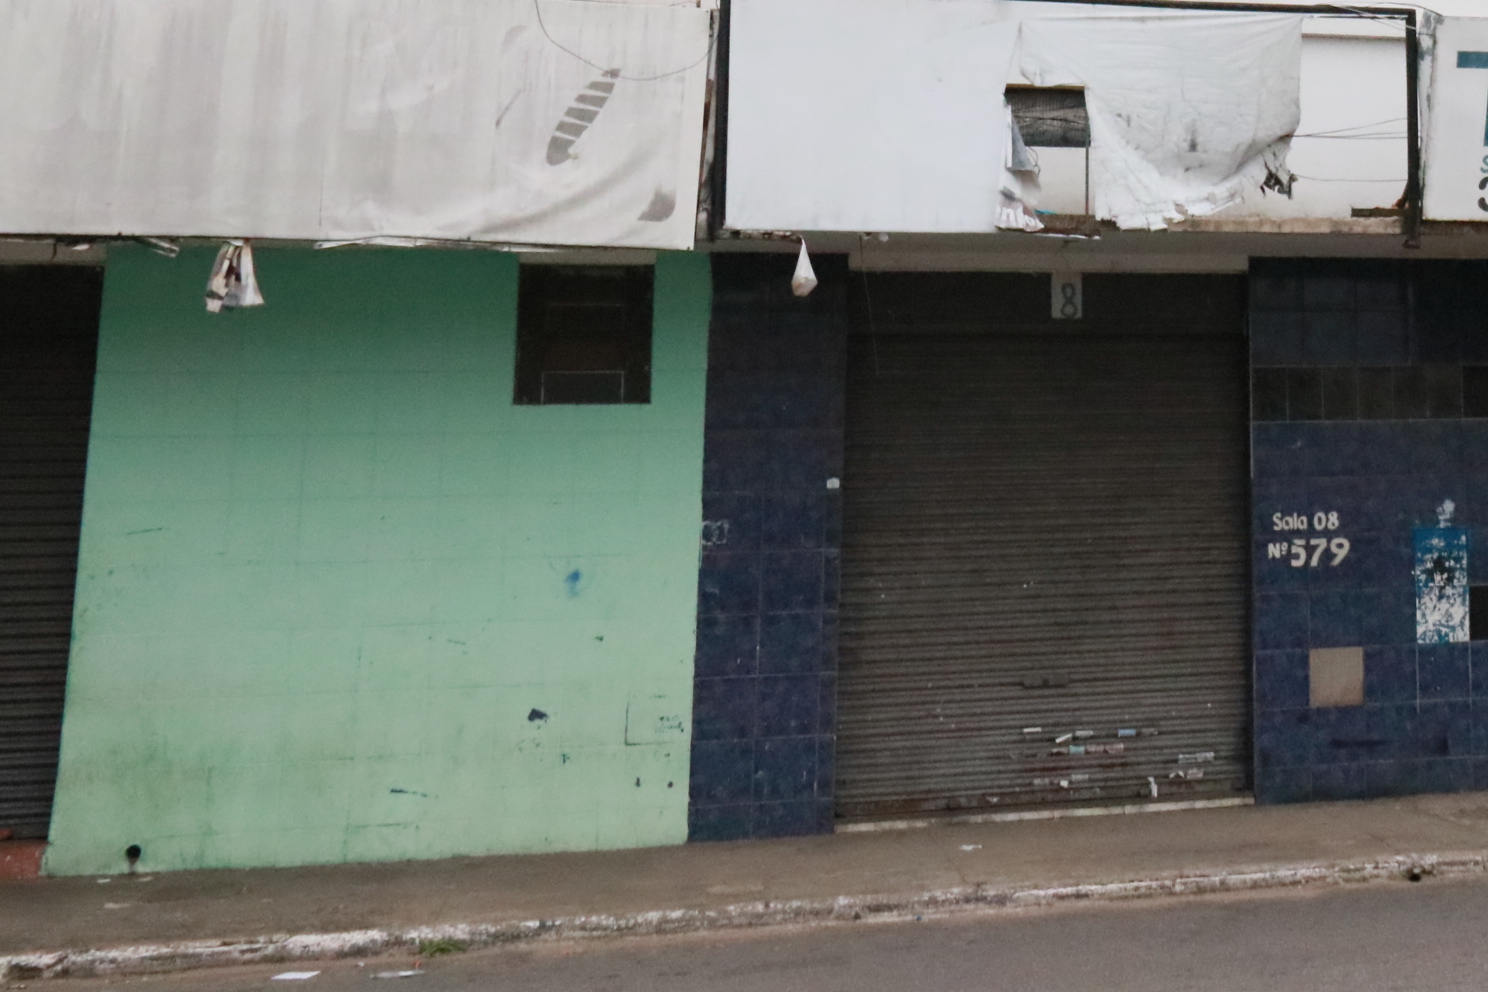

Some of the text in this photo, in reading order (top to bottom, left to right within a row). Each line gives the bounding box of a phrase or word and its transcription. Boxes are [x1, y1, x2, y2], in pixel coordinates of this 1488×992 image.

[1272, 510, 1340, 531] Sala 08
[1290, 537, 1351, 568] 579
